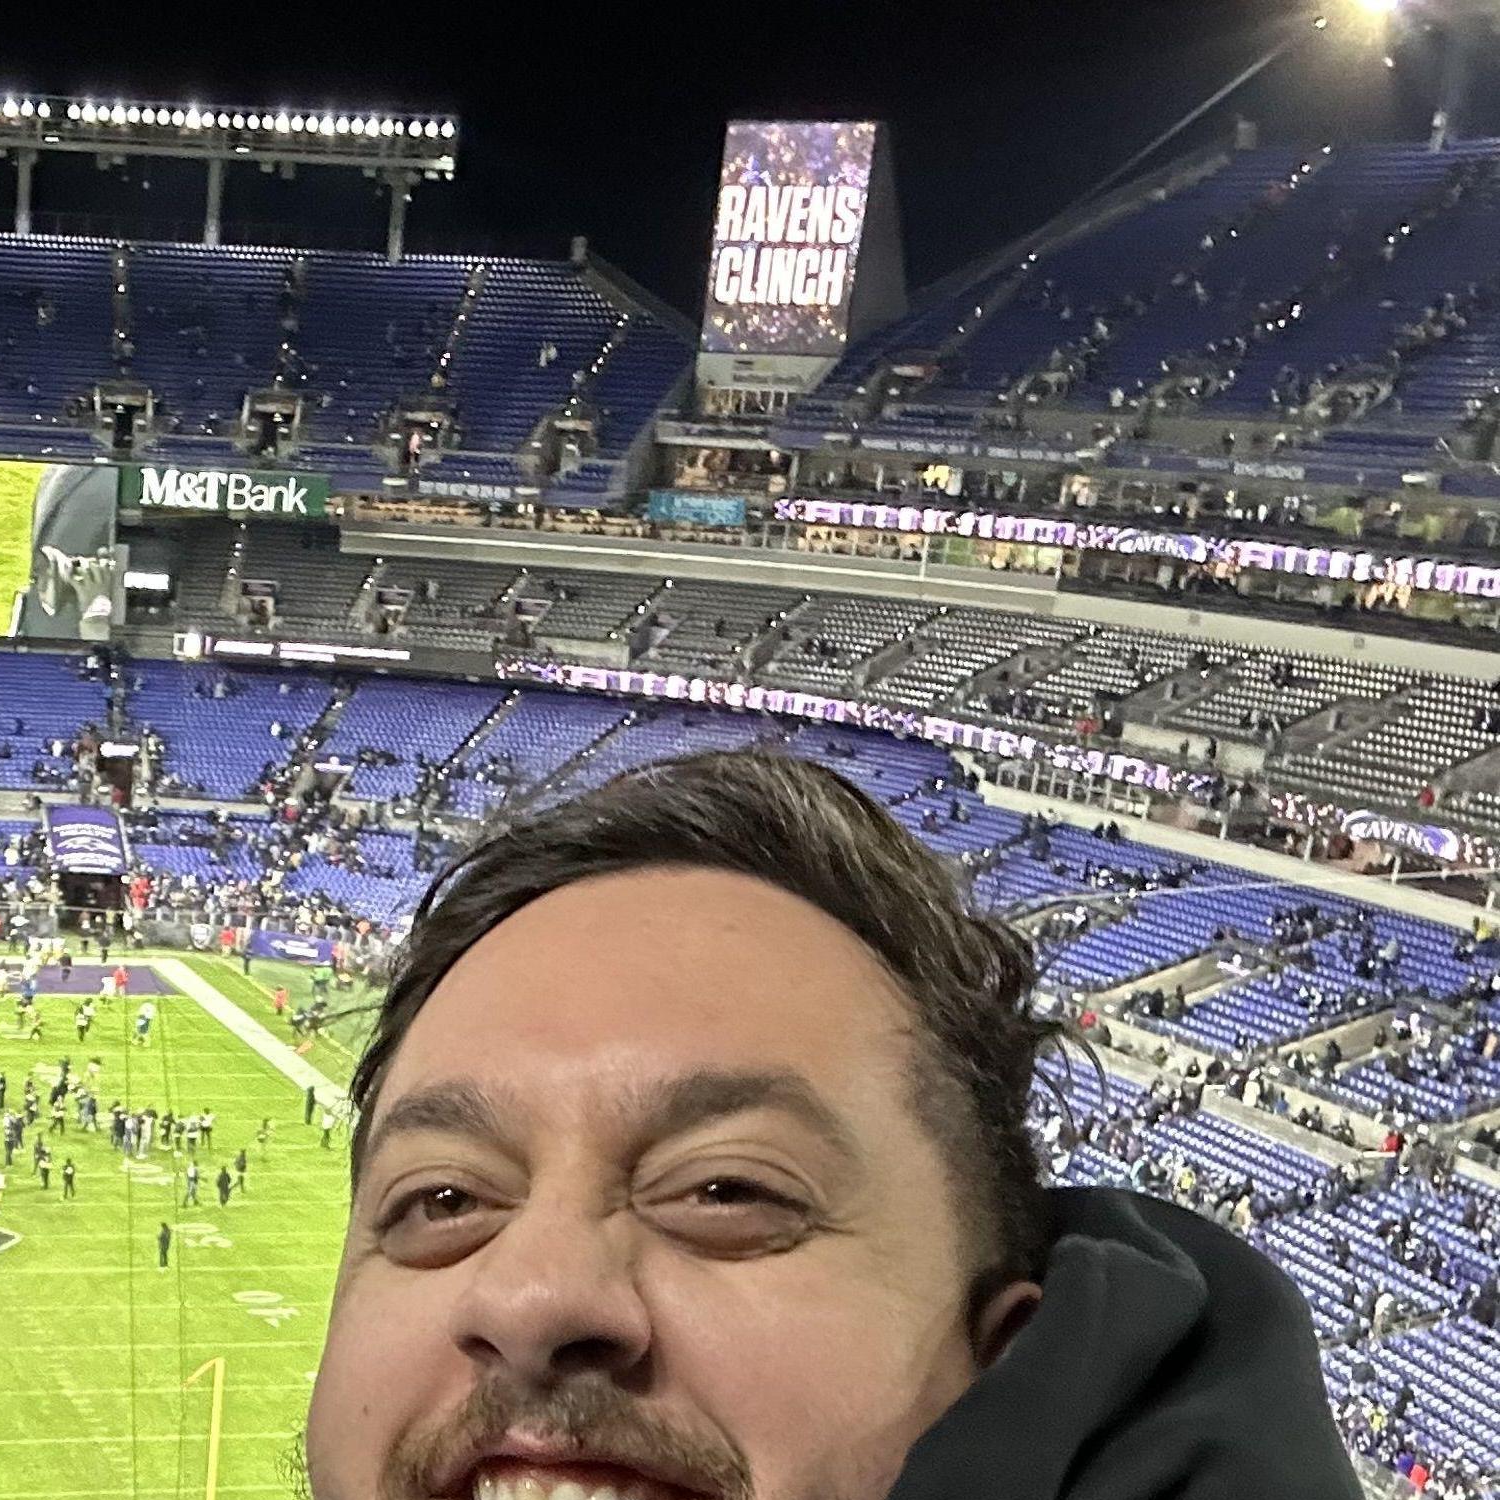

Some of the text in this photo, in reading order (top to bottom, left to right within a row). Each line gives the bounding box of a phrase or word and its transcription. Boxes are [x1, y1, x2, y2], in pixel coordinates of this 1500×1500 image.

[716, 185, 861, 244] RAVENS
[715, 246, 848, 306] CLINCH
[139, 467, 308, 514] M&T Bank
